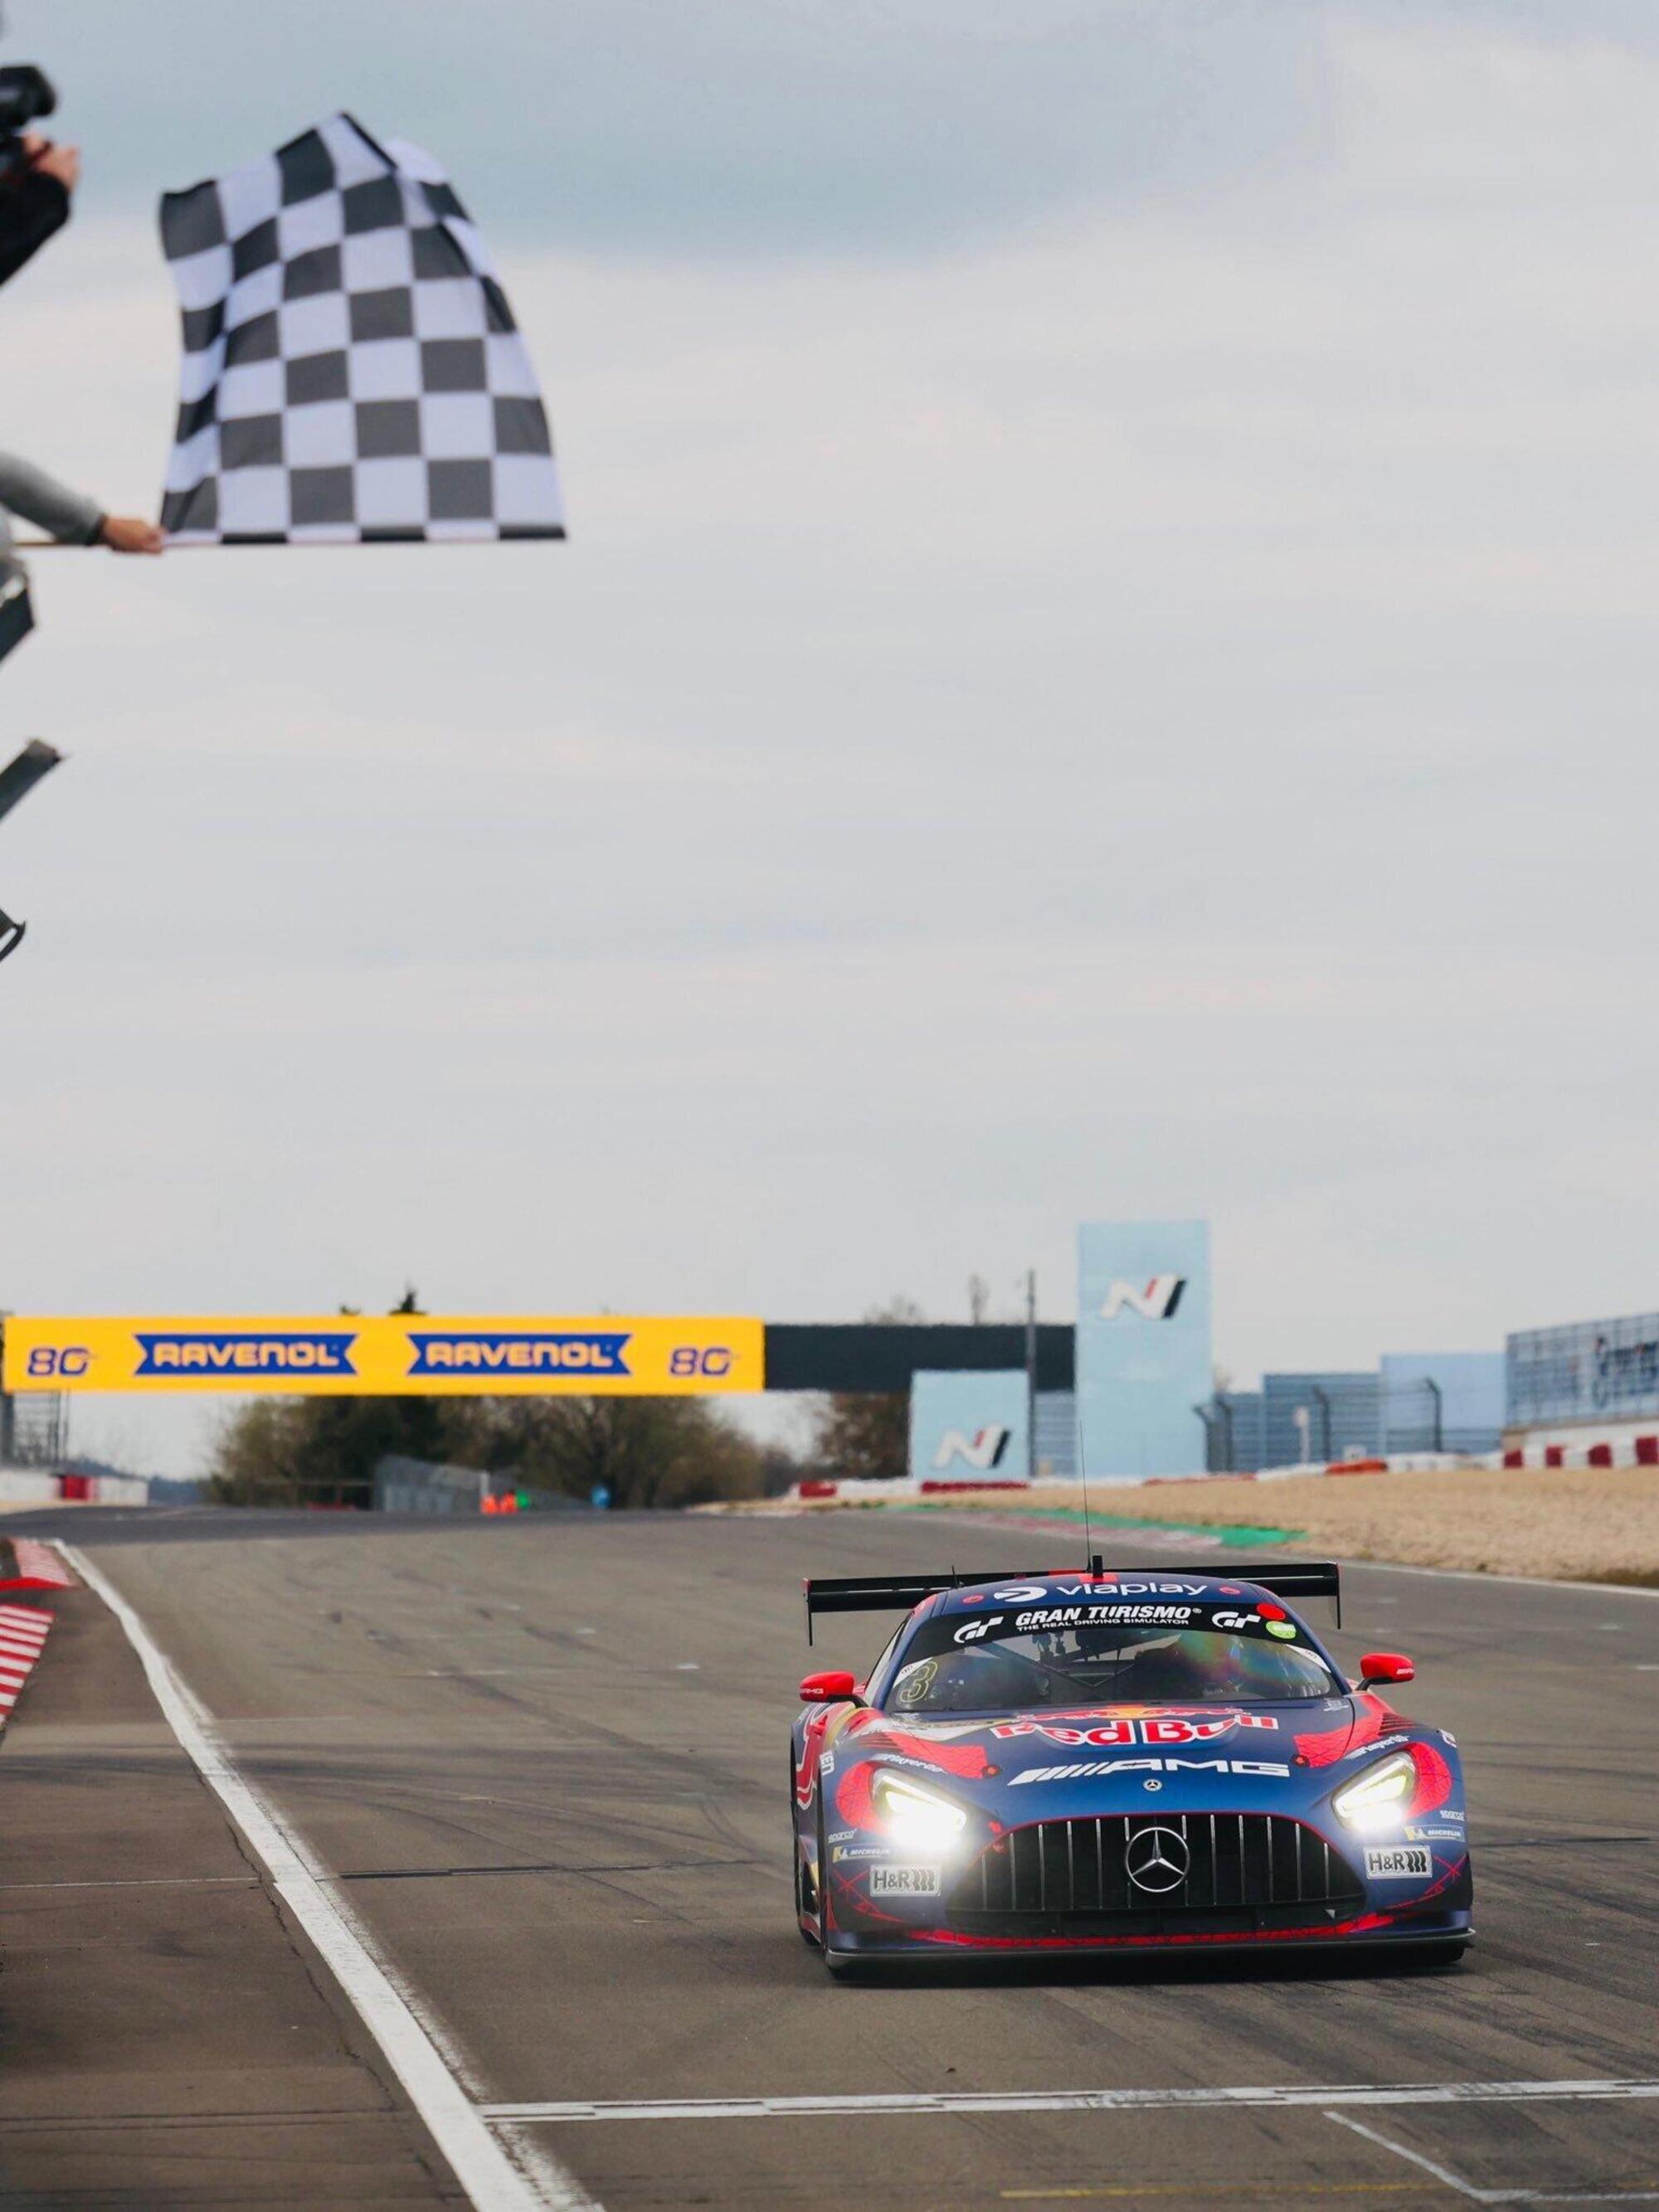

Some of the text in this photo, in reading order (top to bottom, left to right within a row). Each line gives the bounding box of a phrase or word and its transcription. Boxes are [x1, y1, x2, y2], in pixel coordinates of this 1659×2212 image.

[153, 1342, 338, 1367] RAVENOL
[426, 1341, 613, 1367] RAVENOL
[1056, 1582, 1208, 1596] viaplay
[1015, 1607, 1082, 1626] GRAN
[990, 1714, 1280, 1746] Red Bull
[1369, 1853, 1405, 1871] H&R
[873, 1869, 911, 1889] H&R
